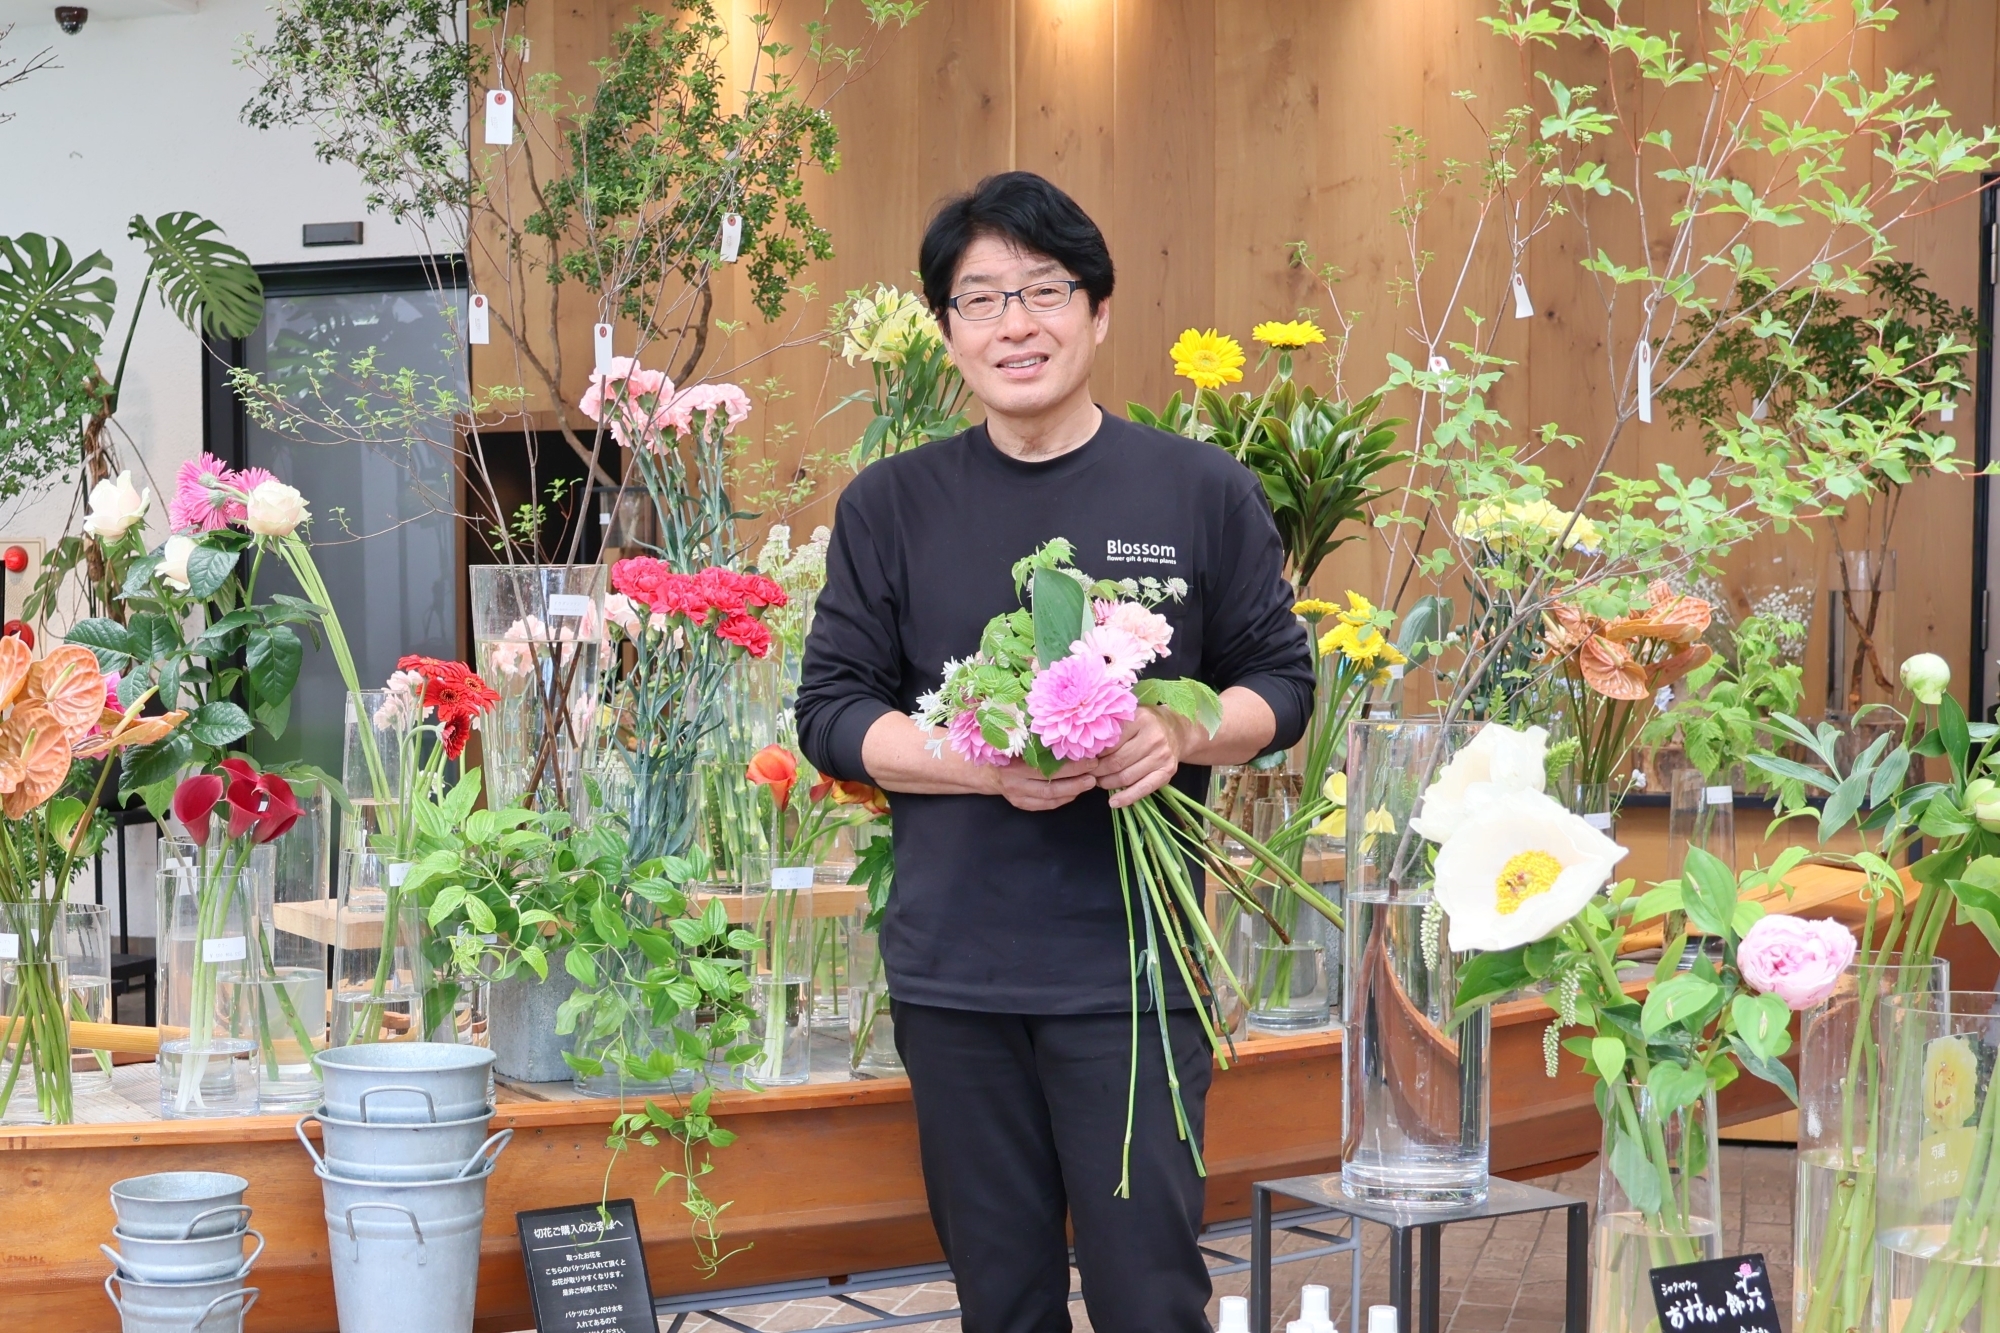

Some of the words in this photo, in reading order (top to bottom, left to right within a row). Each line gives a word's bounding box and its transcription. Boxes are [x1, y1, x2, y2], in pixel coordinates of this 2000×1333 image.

[1107, 539, 1175, 557] Blossom
[566, 1251, 601, 1261] 取ったお花を
[552, 1271, 624, 1286] お花が取りやすくなります。
[562, 1283, 618, 1296] 是非ご利用ください。
[565, 1305, 623, 1318] バケツに少しだけ水を
[576, 1317, 617, 1329] 入れてあるので
